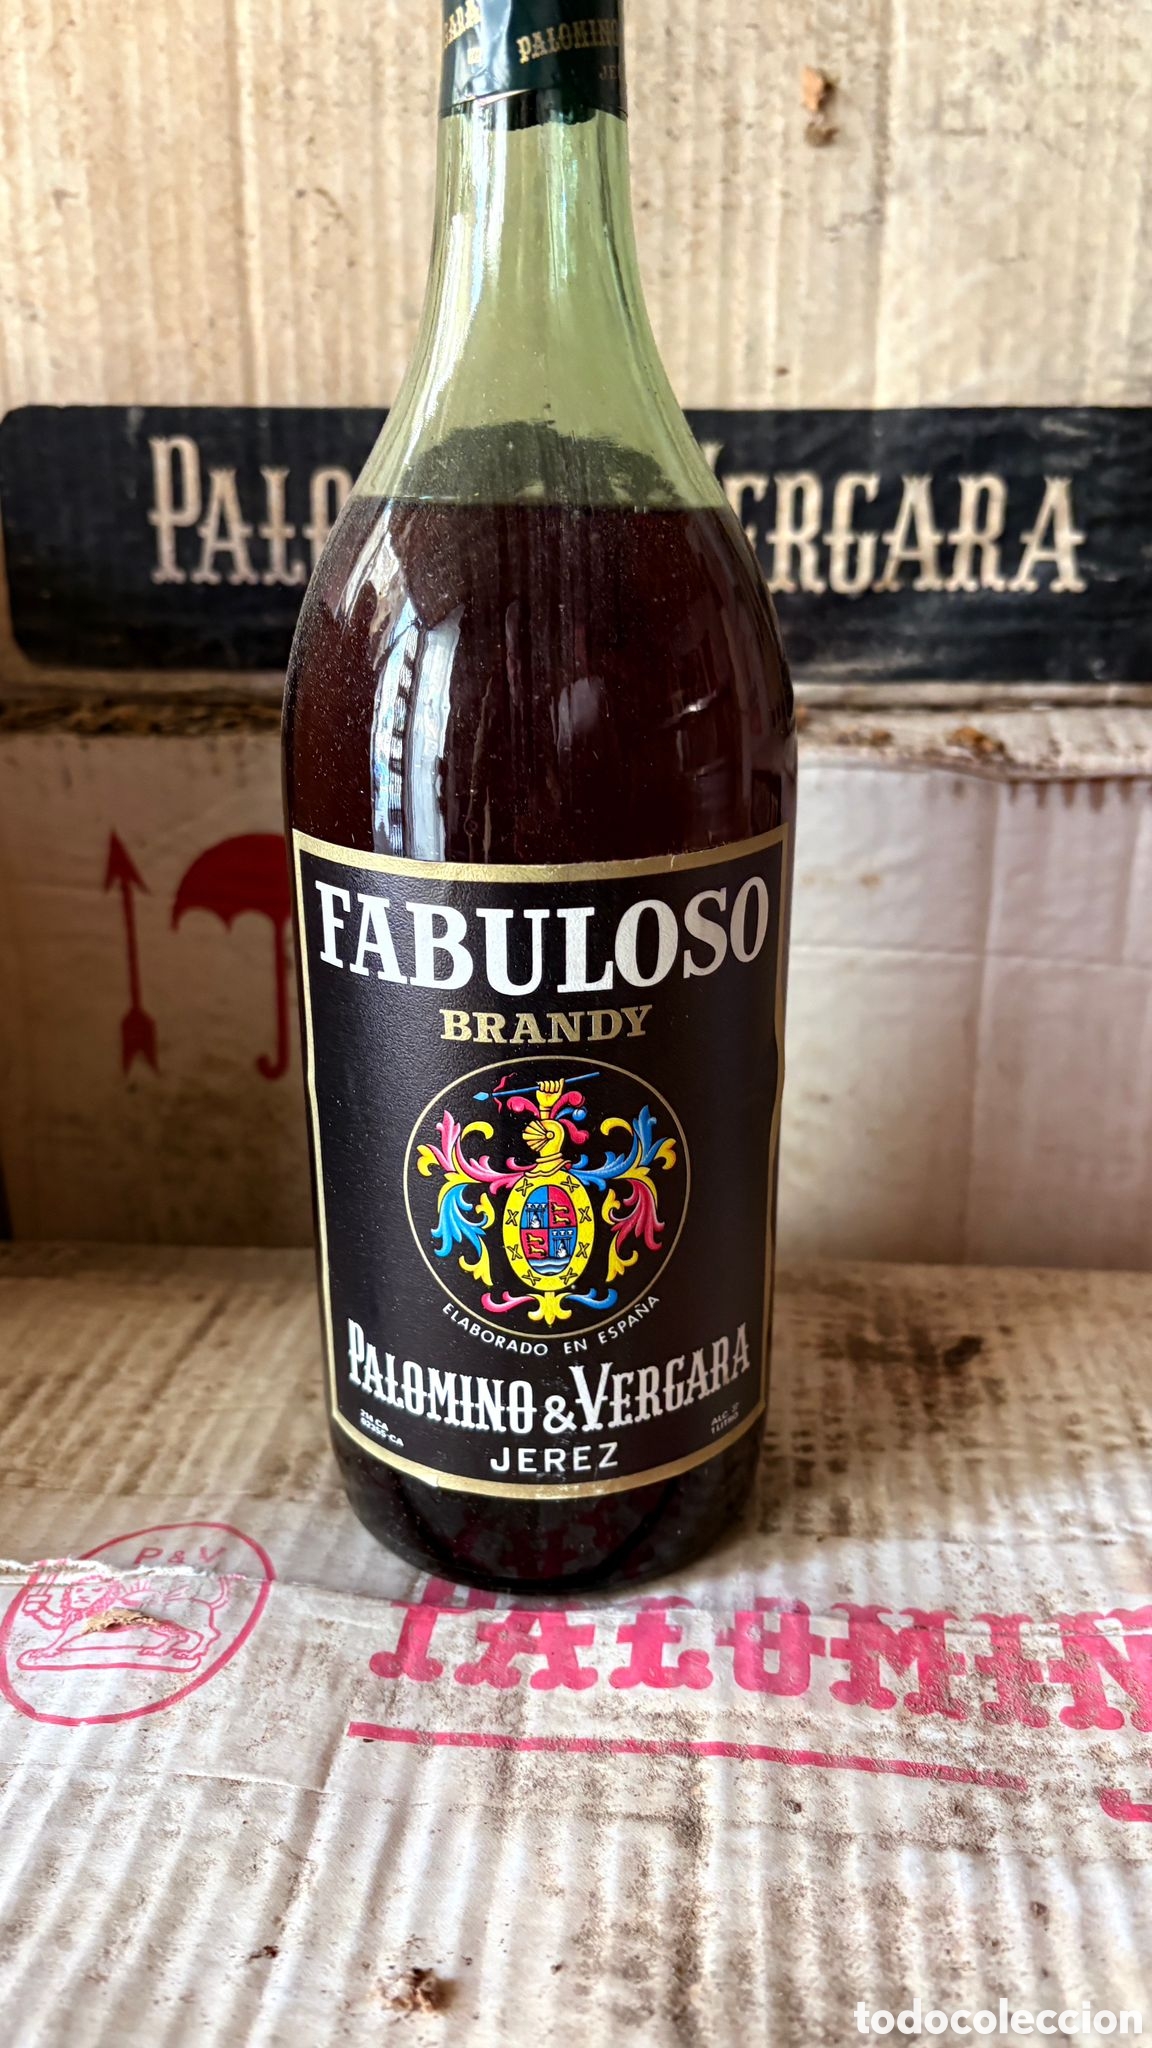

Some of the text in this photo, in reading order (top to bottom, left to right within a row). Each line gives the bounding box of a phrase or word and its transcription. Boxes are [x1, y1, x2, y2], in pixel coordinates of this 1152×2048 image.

[314, 876, 769, 996] FABULOSO
[439, 1004, 653, 1045] BRANDY
[442, 1295, 660, 1356] ELABORADO EN ESPAÑA
[348, 1318, 751, 1435] PALOMINO & VERGARA
[490, 1442, 619, 1474] JEREZ
[134, 1547, 164, 1564] P
[199, 1546, 228, 1564] V
